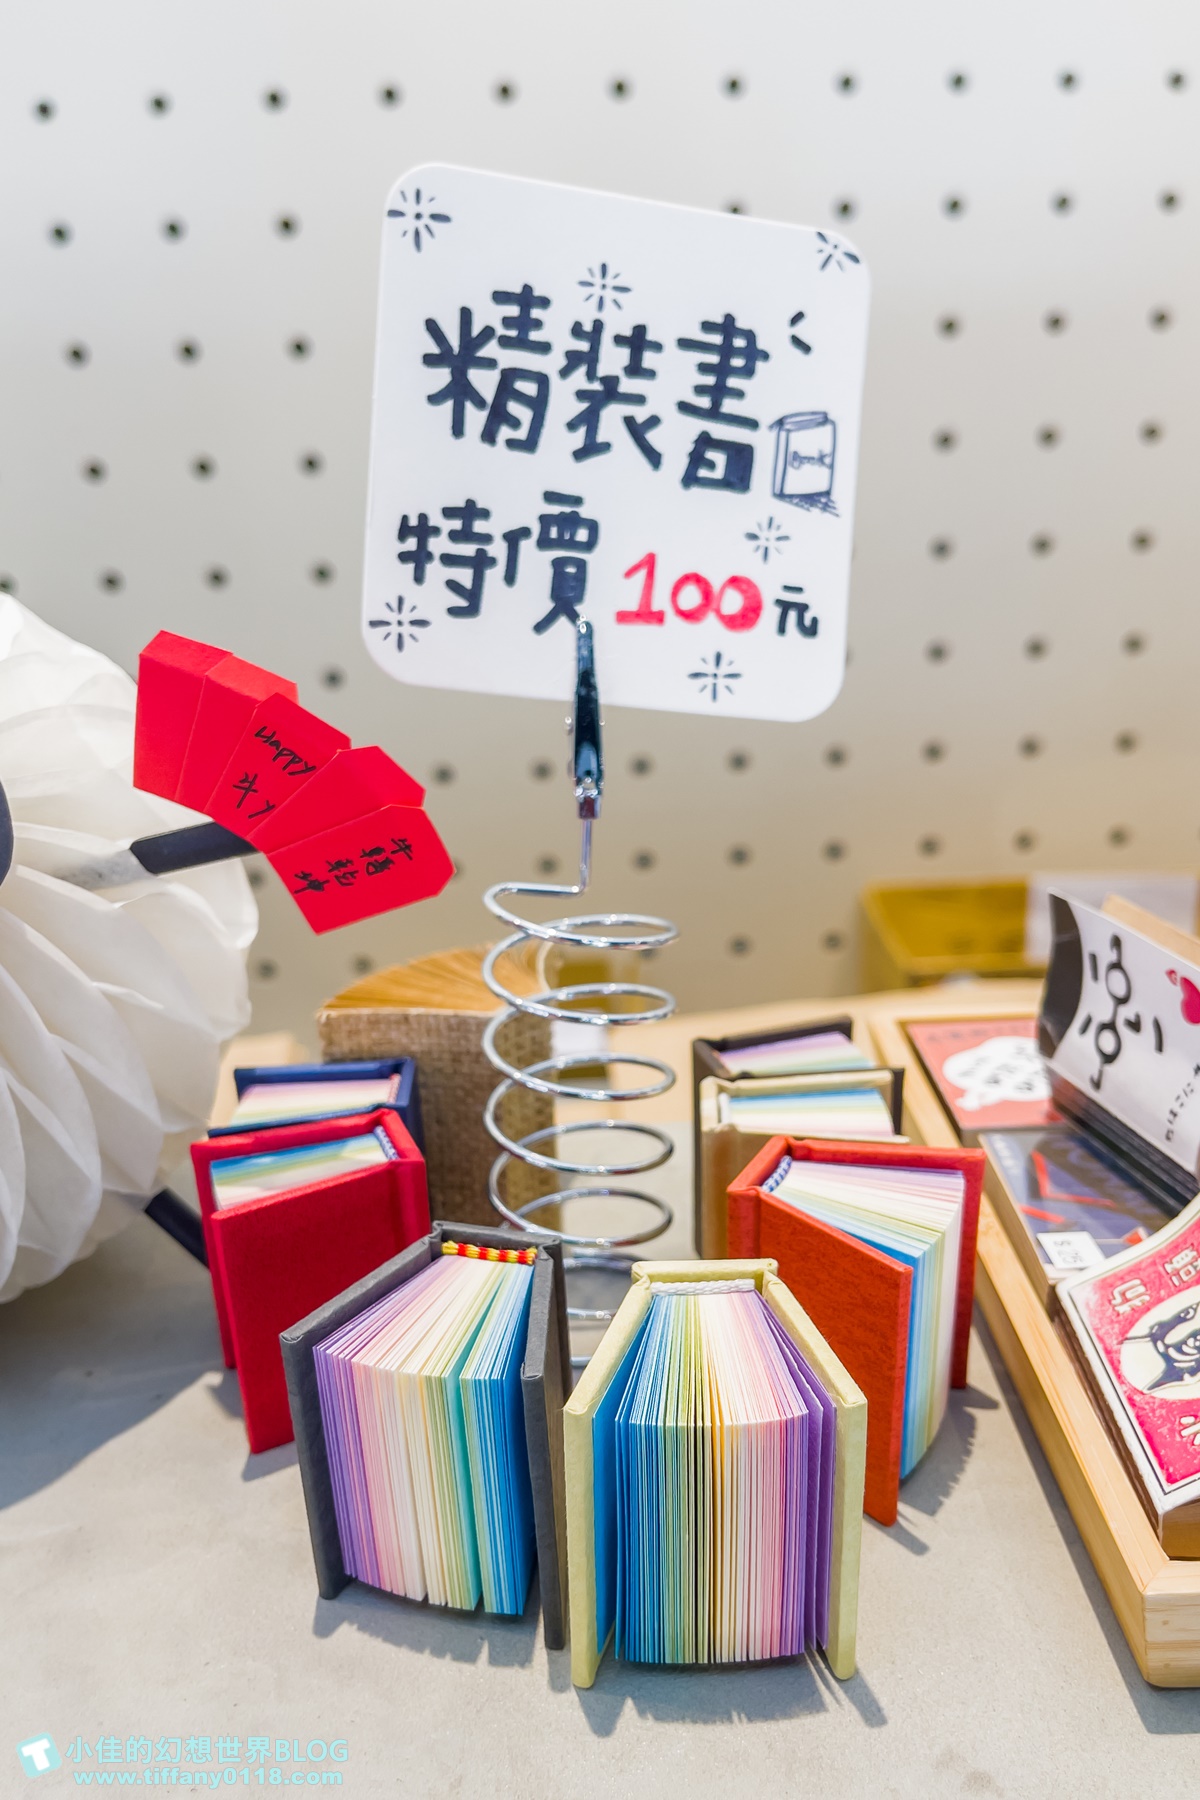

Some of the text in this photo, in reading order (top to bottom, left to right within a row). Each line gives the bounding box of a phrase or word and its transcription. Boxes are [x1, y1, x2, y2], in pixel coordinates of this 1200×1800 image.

[422, 284, 769, 493] 精裝書
[397, 490, 600, 635] 特價
[255, 726, 316, 776] Happy
